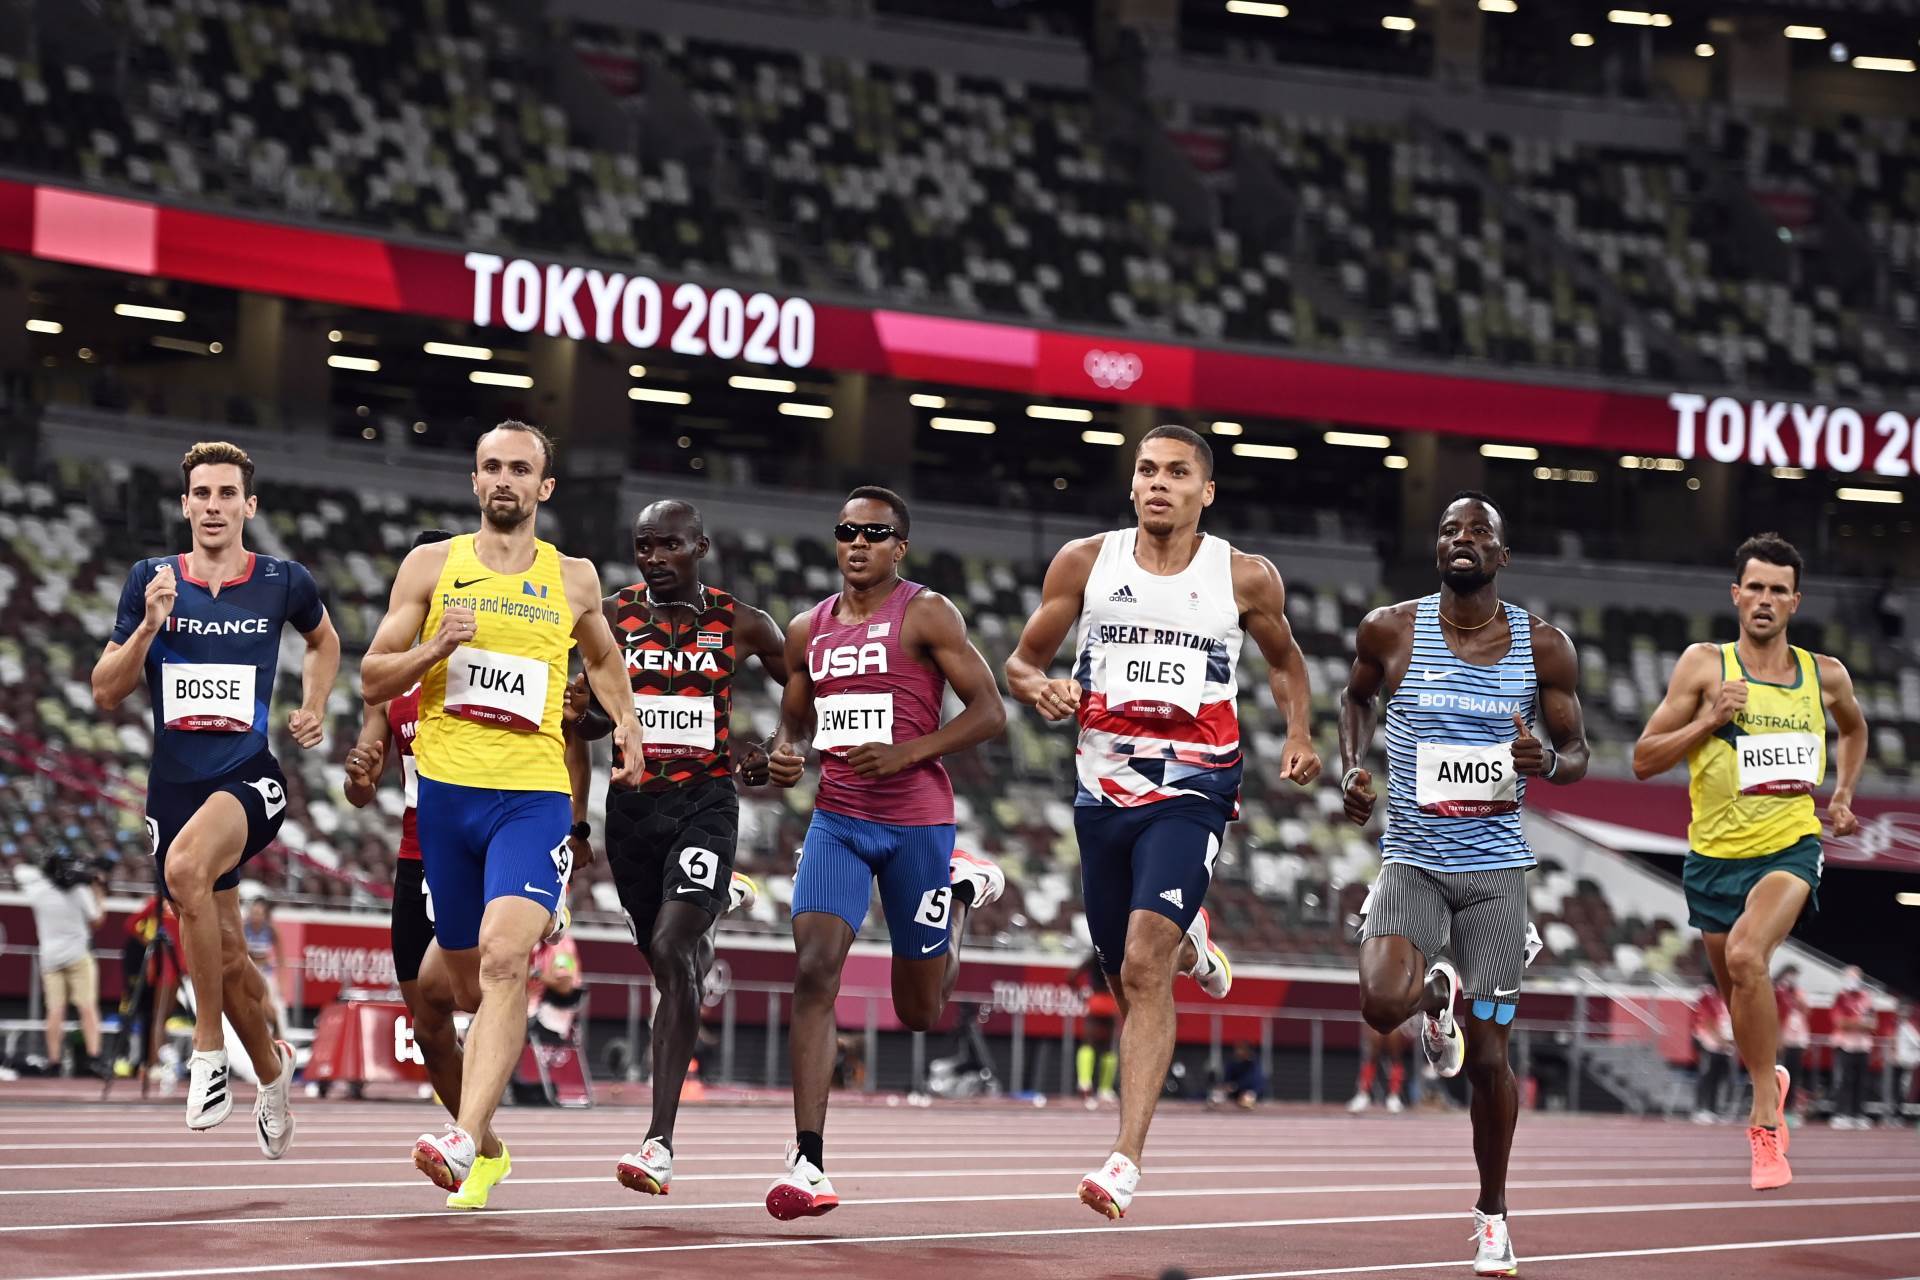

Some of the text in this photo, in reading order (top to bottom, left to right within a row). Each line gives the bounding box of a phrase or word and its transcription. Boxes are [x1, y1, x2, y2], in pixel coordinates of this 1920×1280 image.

[465, 251, 815, 368] TOKYO 2020
[1669, 392, 1920, 478] TOKYO 2
[480, 596, 498, 613] and
[501, 597, 560, 625] Herzegovina
[1109, 594, 1137, 603] adidas
[177, 617, 269, 635] FRANCE
[1100, 625, 1216, 653] GREAT BRITAIN
[625, 648, 719, 673] KENYA
[808, 642, 888, 682] USA
[1126, 660, 1186, 686] GILES
[176, 679, 241, 701] BOSSE
[468, 664, 525, 696] TUKA
[1418, 693, 1521, 714] BOTSWANA
[821, 709, 886, 731] JEWETT
[1736, 712, 1811, 732] AUSTRALIA
[1743, 747, 1815, 768] RISELEY
[1437, 761, 1503, 784] AMOS
[688, 851, 709, 880] 6
[925, 889, 947, 923] 5
[303, 944, 367, 984] TOKYO
